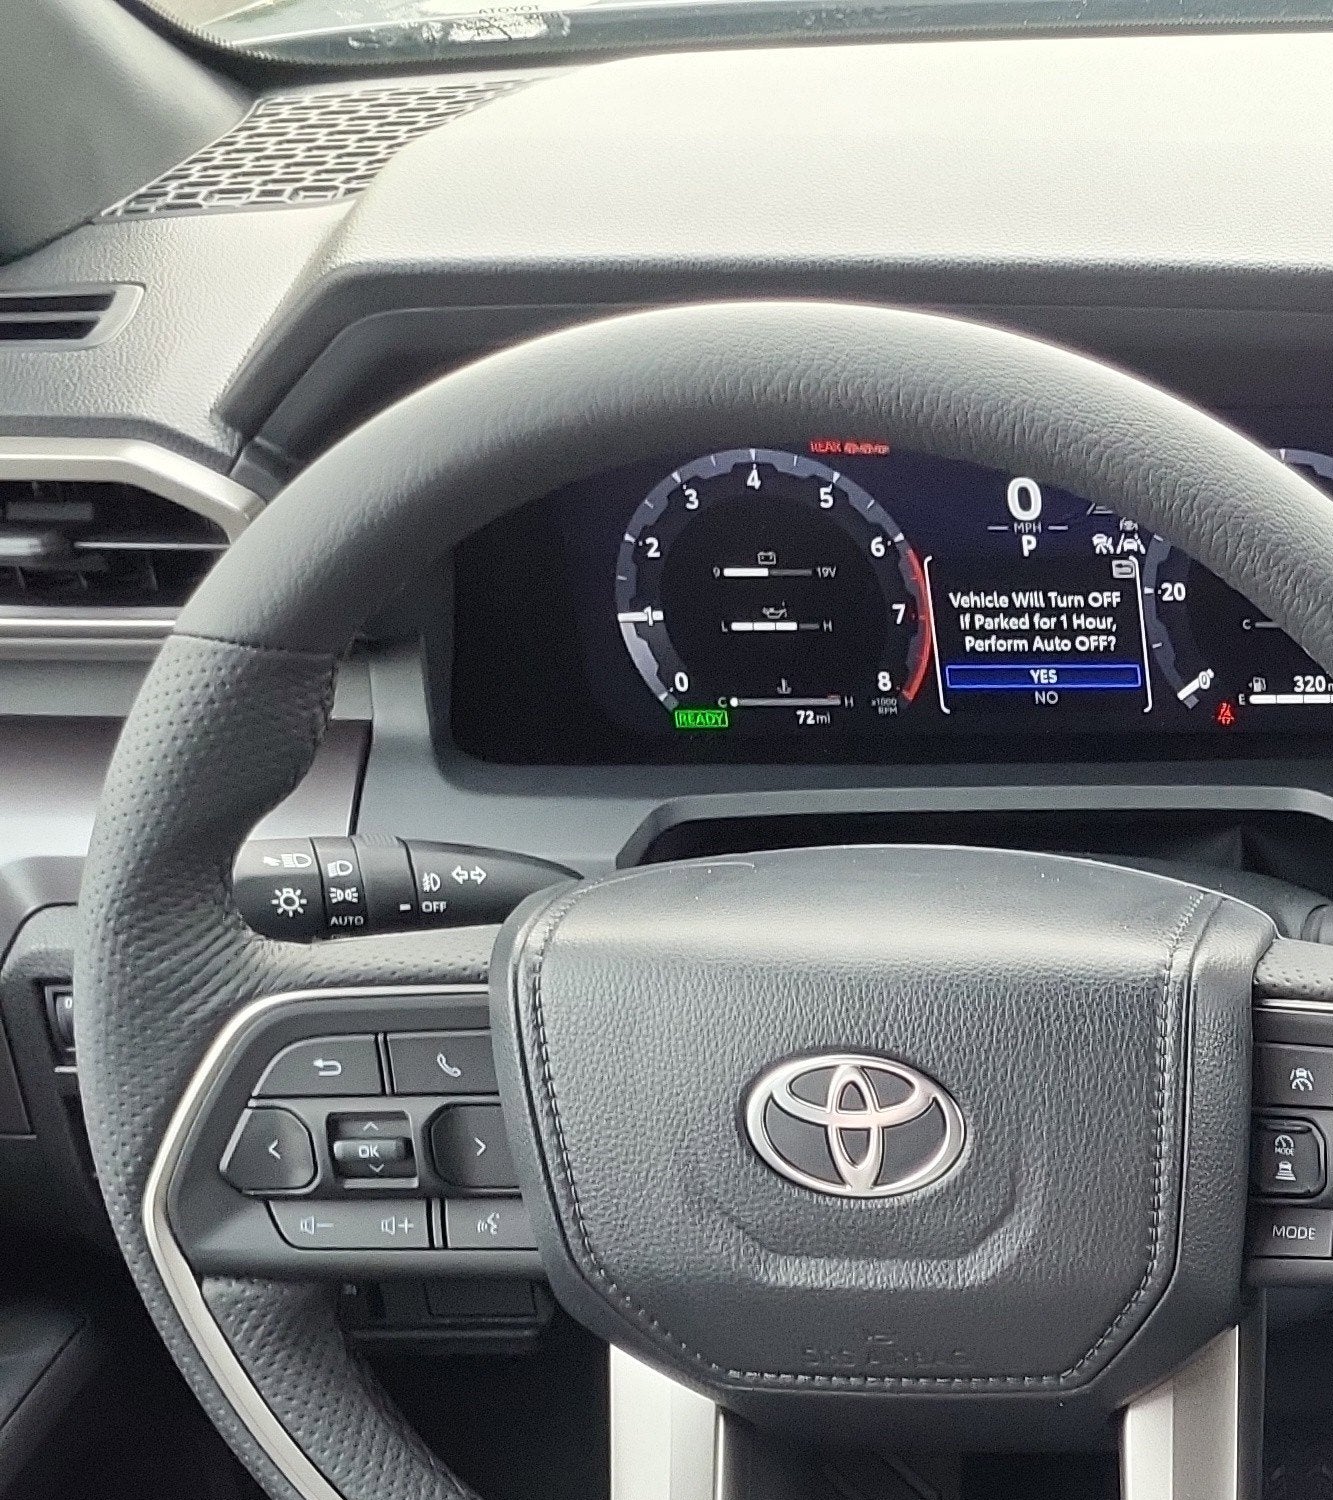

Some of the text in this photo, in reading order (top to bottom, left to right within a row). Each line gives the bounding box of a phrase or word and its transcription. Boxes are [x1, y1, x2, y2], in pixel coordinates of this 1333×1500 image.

[747, 470, 760, 490] 4
[685, 489, 699, 510] 3
[819, 487, 834, 509] 5
[1007, 477, 1042, 521] 0
[1013, 523, 1042, 533] MPH
[645, 537, 661, 558] 2
[870, 537, 885, 557] 6
[1022, 535, 1037, 557] P
[949, 591, 1122, 609] Vehicle Will Turn OFF
[1161, 583, 1186, 601] 20
[892, 603, 906, 625] 7
[960, 613, 1117, 633] If Parked for 1 Hour,
[1242, 619, 1252, 630] C
[964, 635, 1116, 652] Perform Auto OFF?
[674, 672, 689, 692] 0
[878, 672, 892, 692] 8
[1029, 669, 1058, 684] YES
[1293, 676, 1326, 692] 320
[718, 696, 727, 707] C
[1034, 691, 1059, 705] NO
[679, 713, 725, 726] READY
[796, 710, 815, 725] 72
[421, 901, 447, 913] OFF
[330, 915, 364, 926] AUTO
[358, 1145, 381, 1159] OK
[1272, 1225, 1316, 1240] MODE
